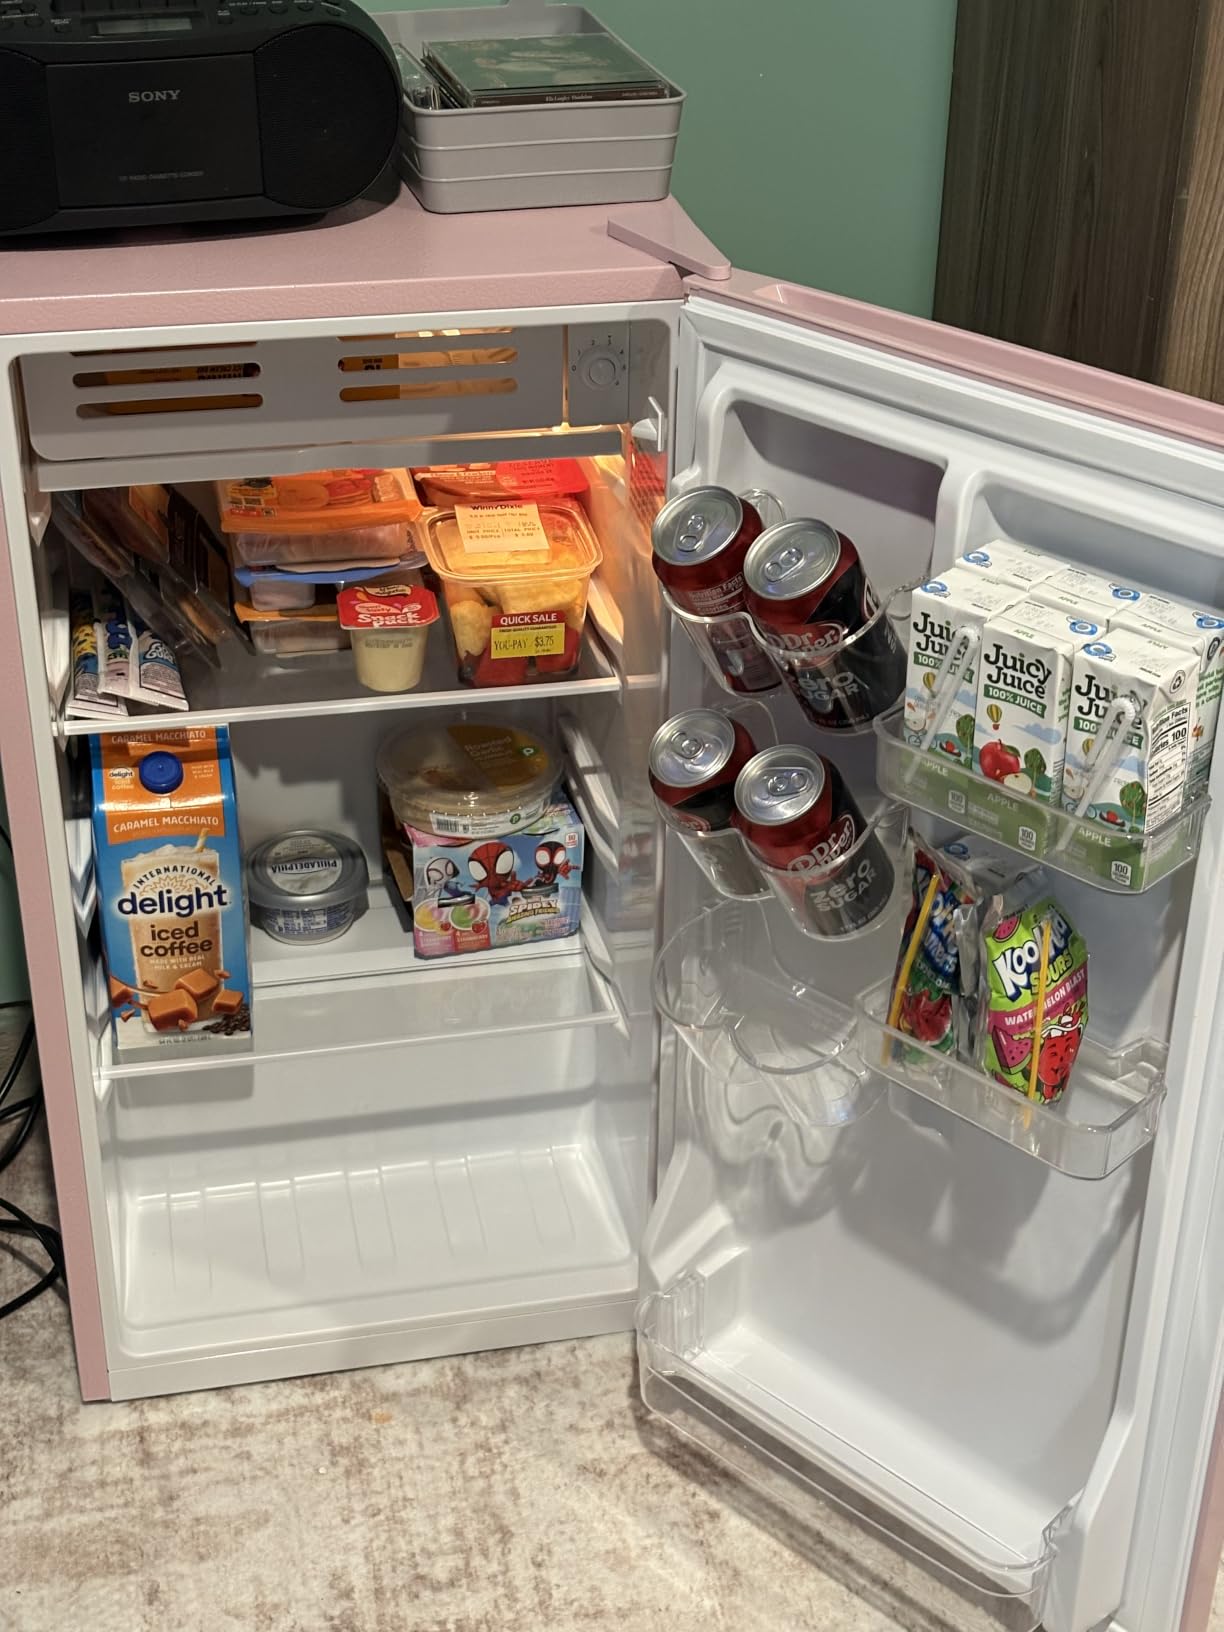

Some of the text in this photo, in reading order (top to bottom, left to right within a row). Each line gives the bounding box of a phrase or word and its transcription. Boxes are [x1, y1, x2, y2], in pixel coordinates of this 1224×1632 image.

[128, 89, 181, 103] SONY
[499, 612, 558, 626] QUICK SALE
[983, 643, 1053, 686] Juicy
[987, 665, 1046, 700] Juice
[988, 686, 1043, 715] 100% JUICE
[111, 729, 207, 745] CARAMEL MACCHIATO
[1171, 727, 1187, 742] 100
[113, 814, 219, 833] CARAMEL MACCHIATO
[1077, 826, 1112, 848] APPLE
[271, 858, 338, 874] PHILADELPHIA
[1113, 862, 1128, 876] 100
[132, 864, 217, 890] INTERNATIONAL
[815, 866, 877, 912] SUGAR
[117, 884, 229, 918] delight
[150, 920, 200, 941] iced
[140, 938, 214, 957] coffee
[1065, 968, 1086, 992] BLAST
